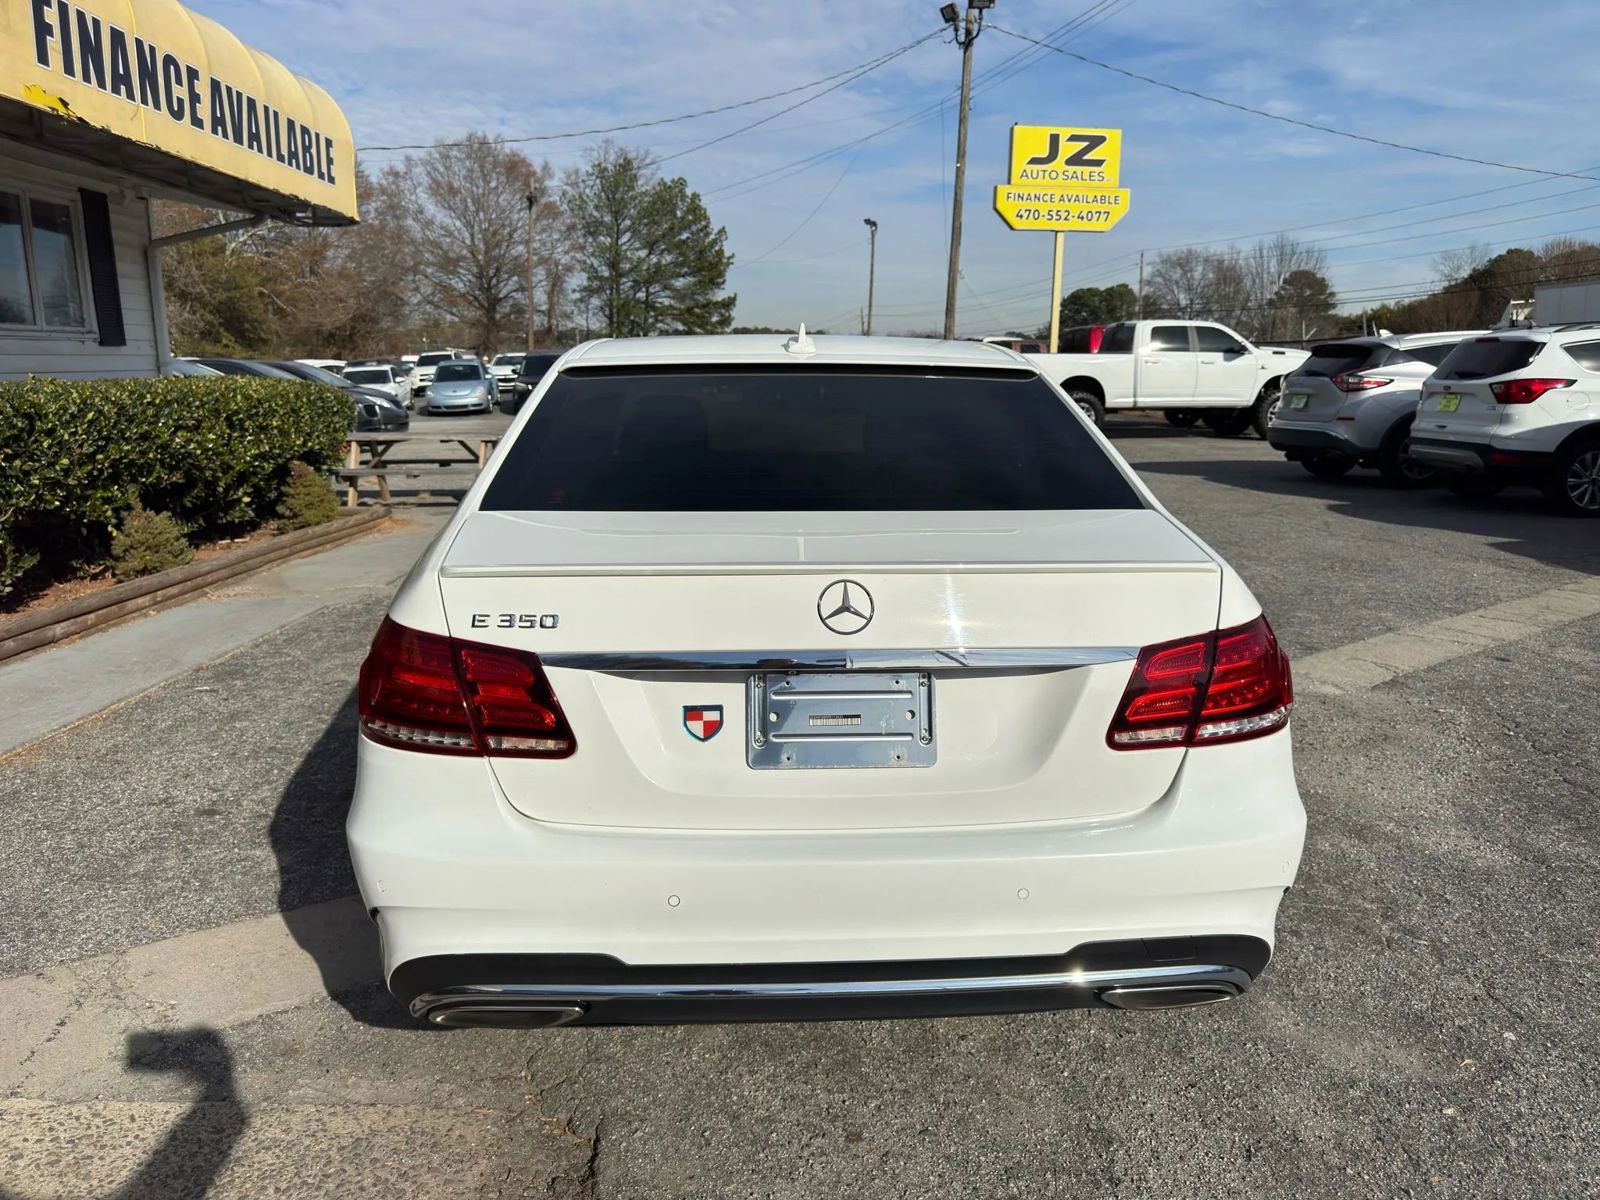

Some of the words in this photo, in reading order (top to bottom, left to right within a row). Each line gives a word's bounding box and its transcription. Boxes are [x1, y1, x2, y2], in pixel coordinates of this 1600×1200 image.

[31, 0, 206, 131] FINANCE
[208, 75, 336, 185] AVAILABLE
[1026, 132, 1107, 167] JZ
[1019, 169, 1059, 181] AUTO
[1061, 170, 1105, 182] SALES
[1006, 192, 1055, 203] FINANCE
[1058, 194, 1120, 205] AVAILABLE
[1015, 208, 1110, 222] 470-552-4077
[471, 614, 491, 628] E
[497, 613, 559, 629] 350
